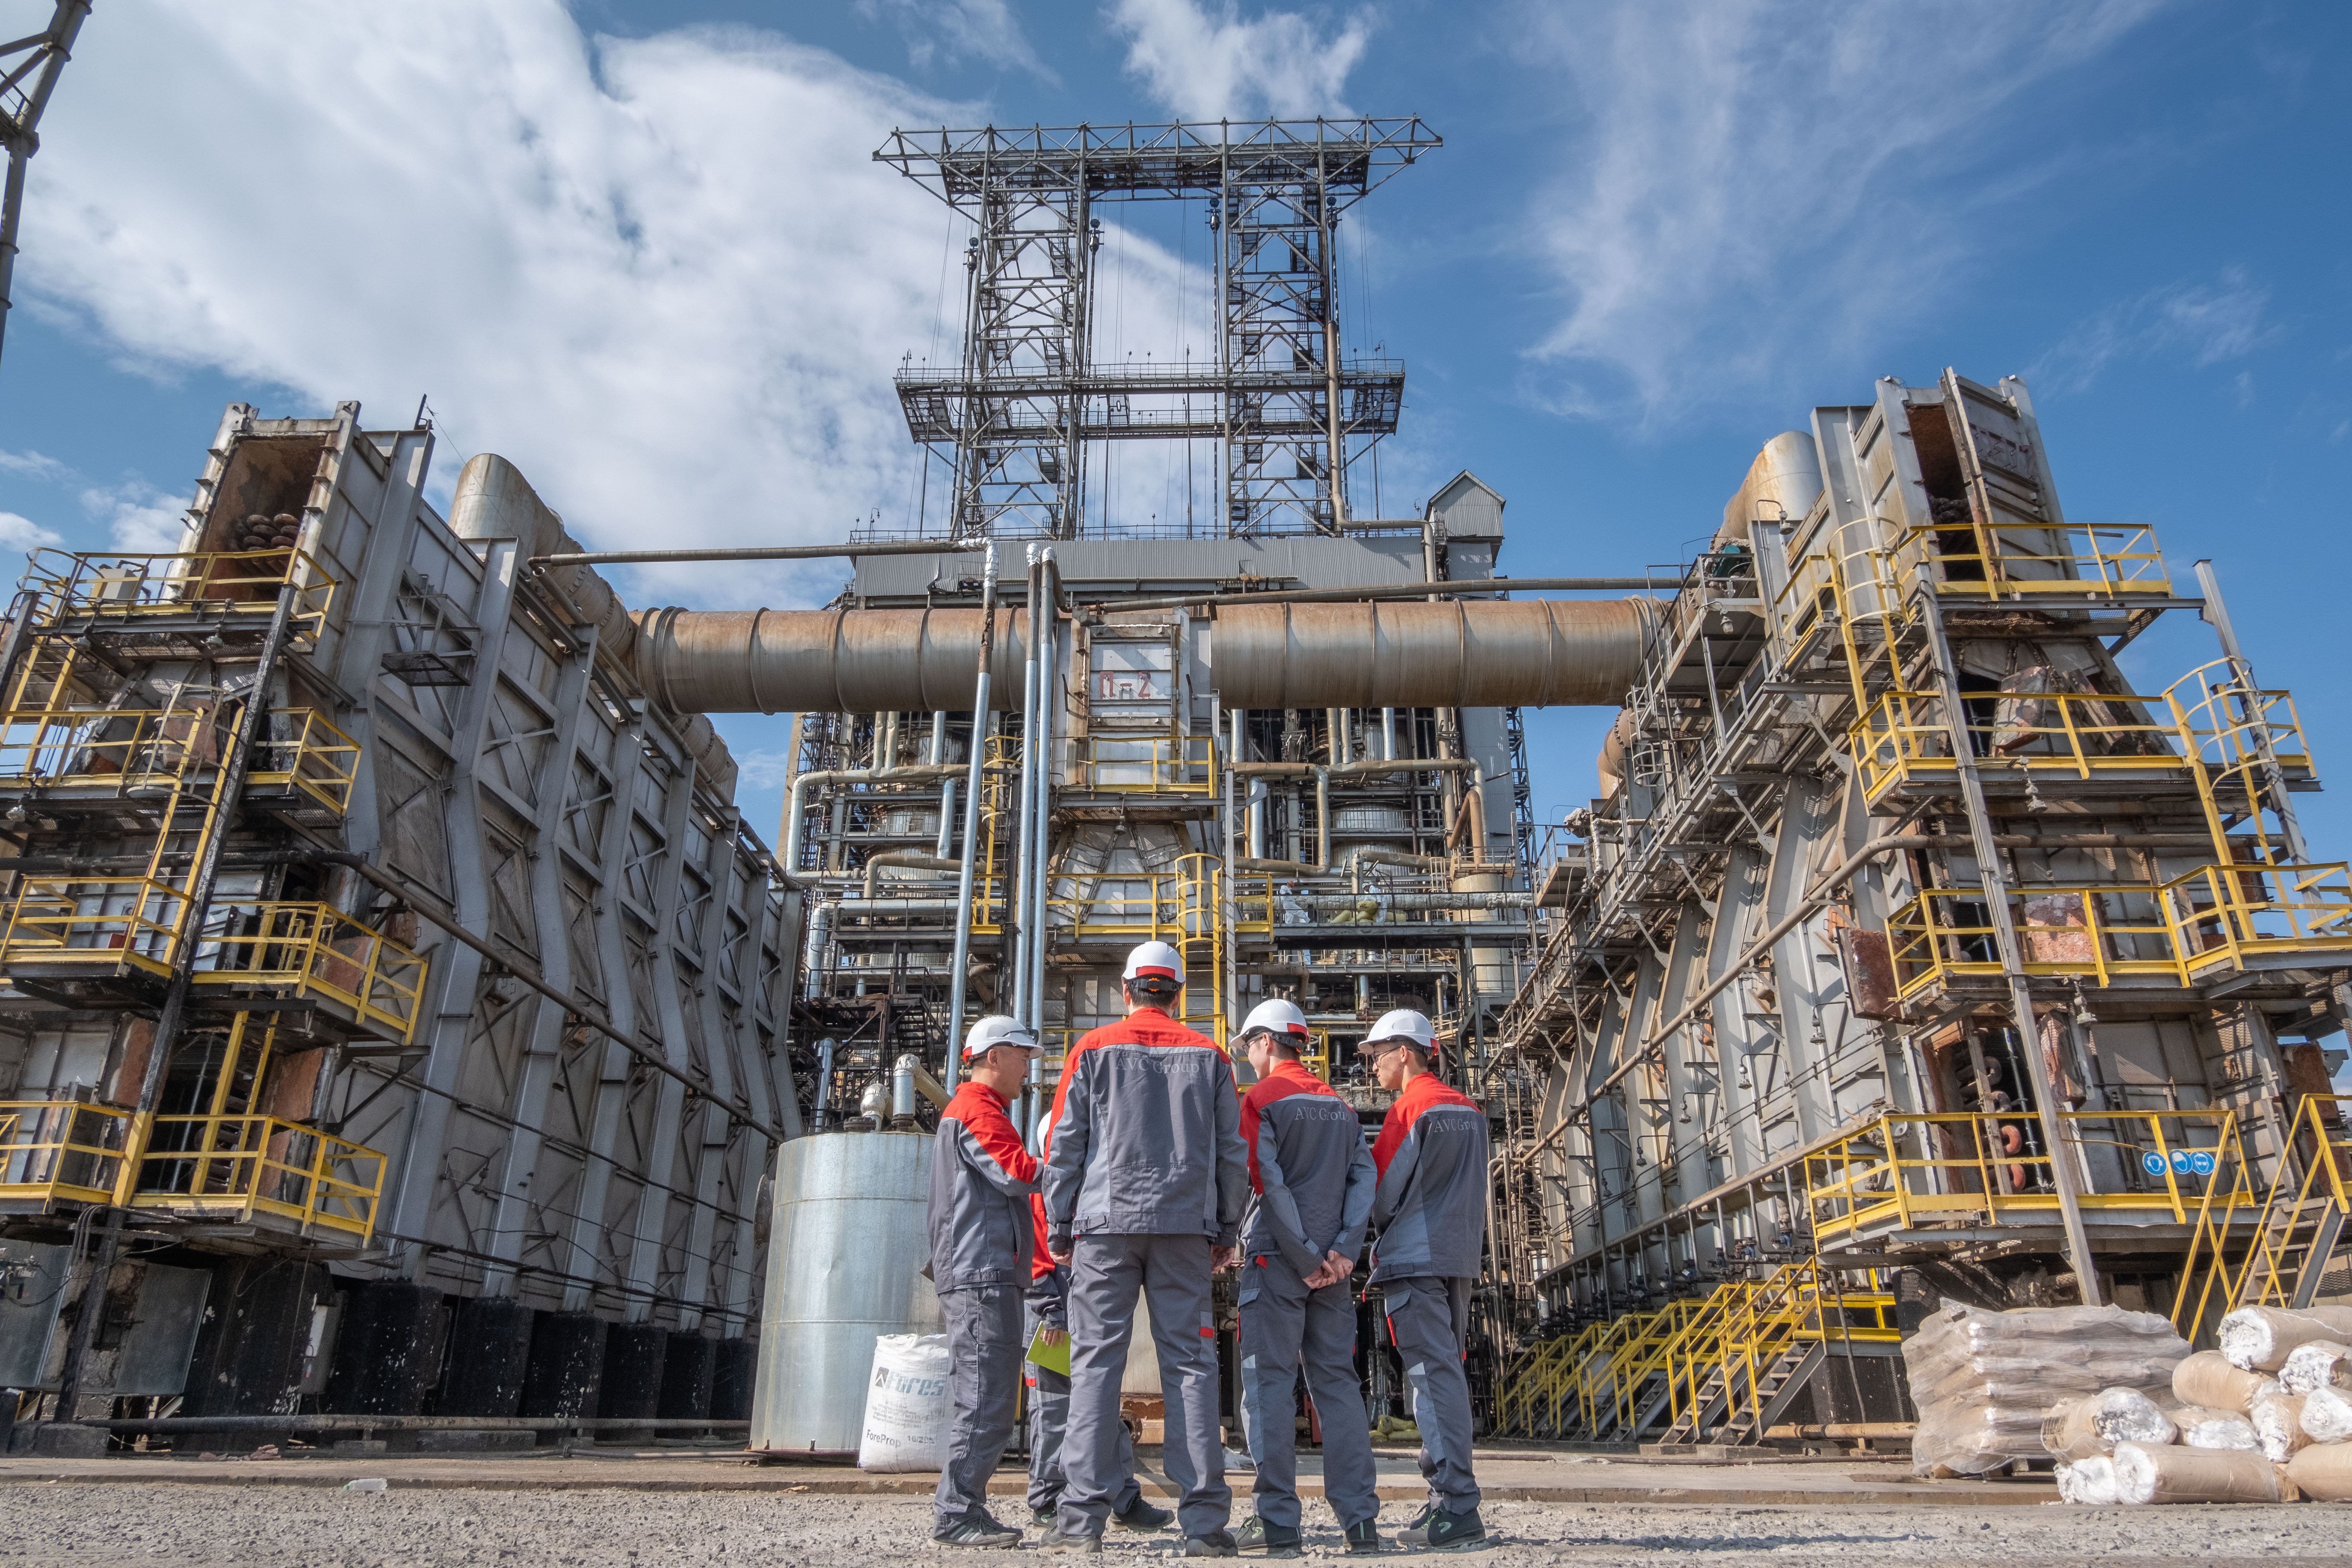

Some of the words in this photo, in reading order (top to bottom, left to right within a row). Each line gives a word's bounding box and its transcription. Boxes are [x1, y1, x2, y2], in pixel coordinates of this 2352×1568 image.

[1099, 671, 1151, 697] П-2
[1115, 1058, 1148, 1071] AVC
[1153, 1061, 1199, 1077] Group
[1295, 1106, 1317, 1120] AVC
[1434, 1119, 1456, 1133] AVC
[887, 1370, 946, 1396] Fores
[867, 1429, 901, 1448] ForeProp
